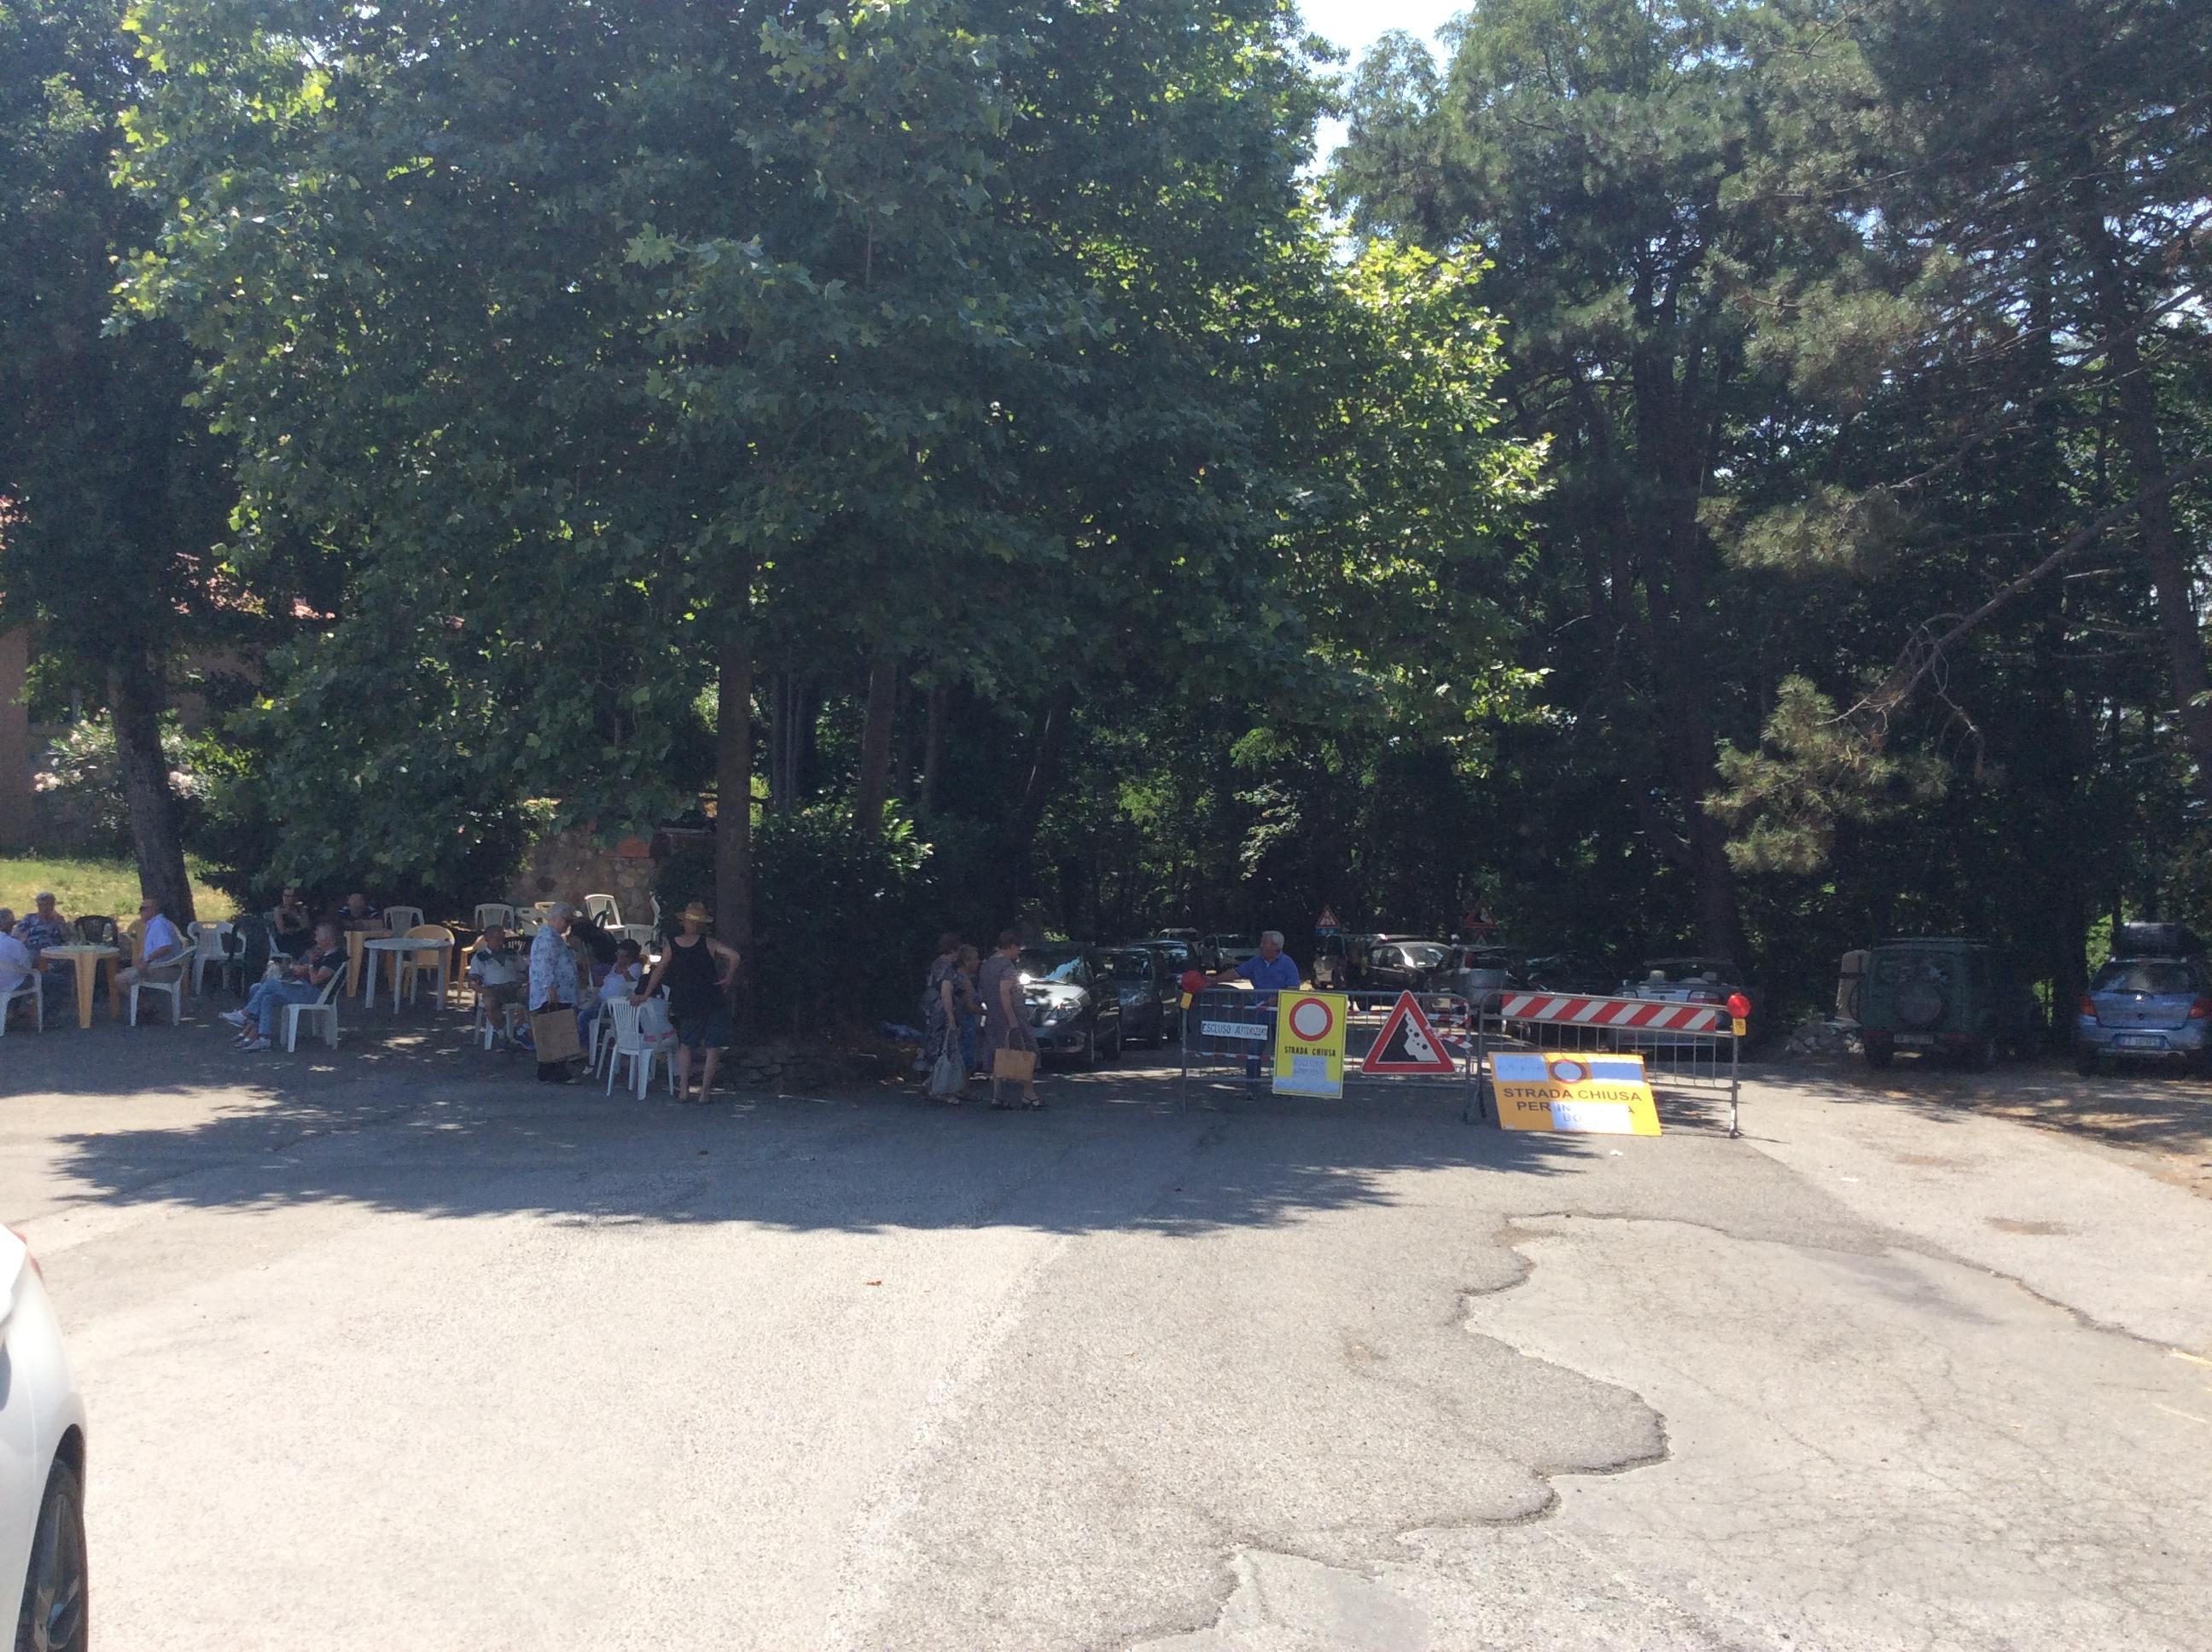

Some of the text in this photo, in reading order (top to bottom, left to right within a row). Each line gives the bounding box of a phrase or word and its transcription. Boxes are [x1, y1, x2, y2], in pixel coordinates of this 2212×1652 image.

[1202, 1023, 1231, 1034] ESCLUSO
[1284, 1046, 1336, 1057] STRADA CHIUSA
[1504, 1087, 1642, 1102] STRADA CHIUSA
[1516, 1101, 1551, 1113] PER
